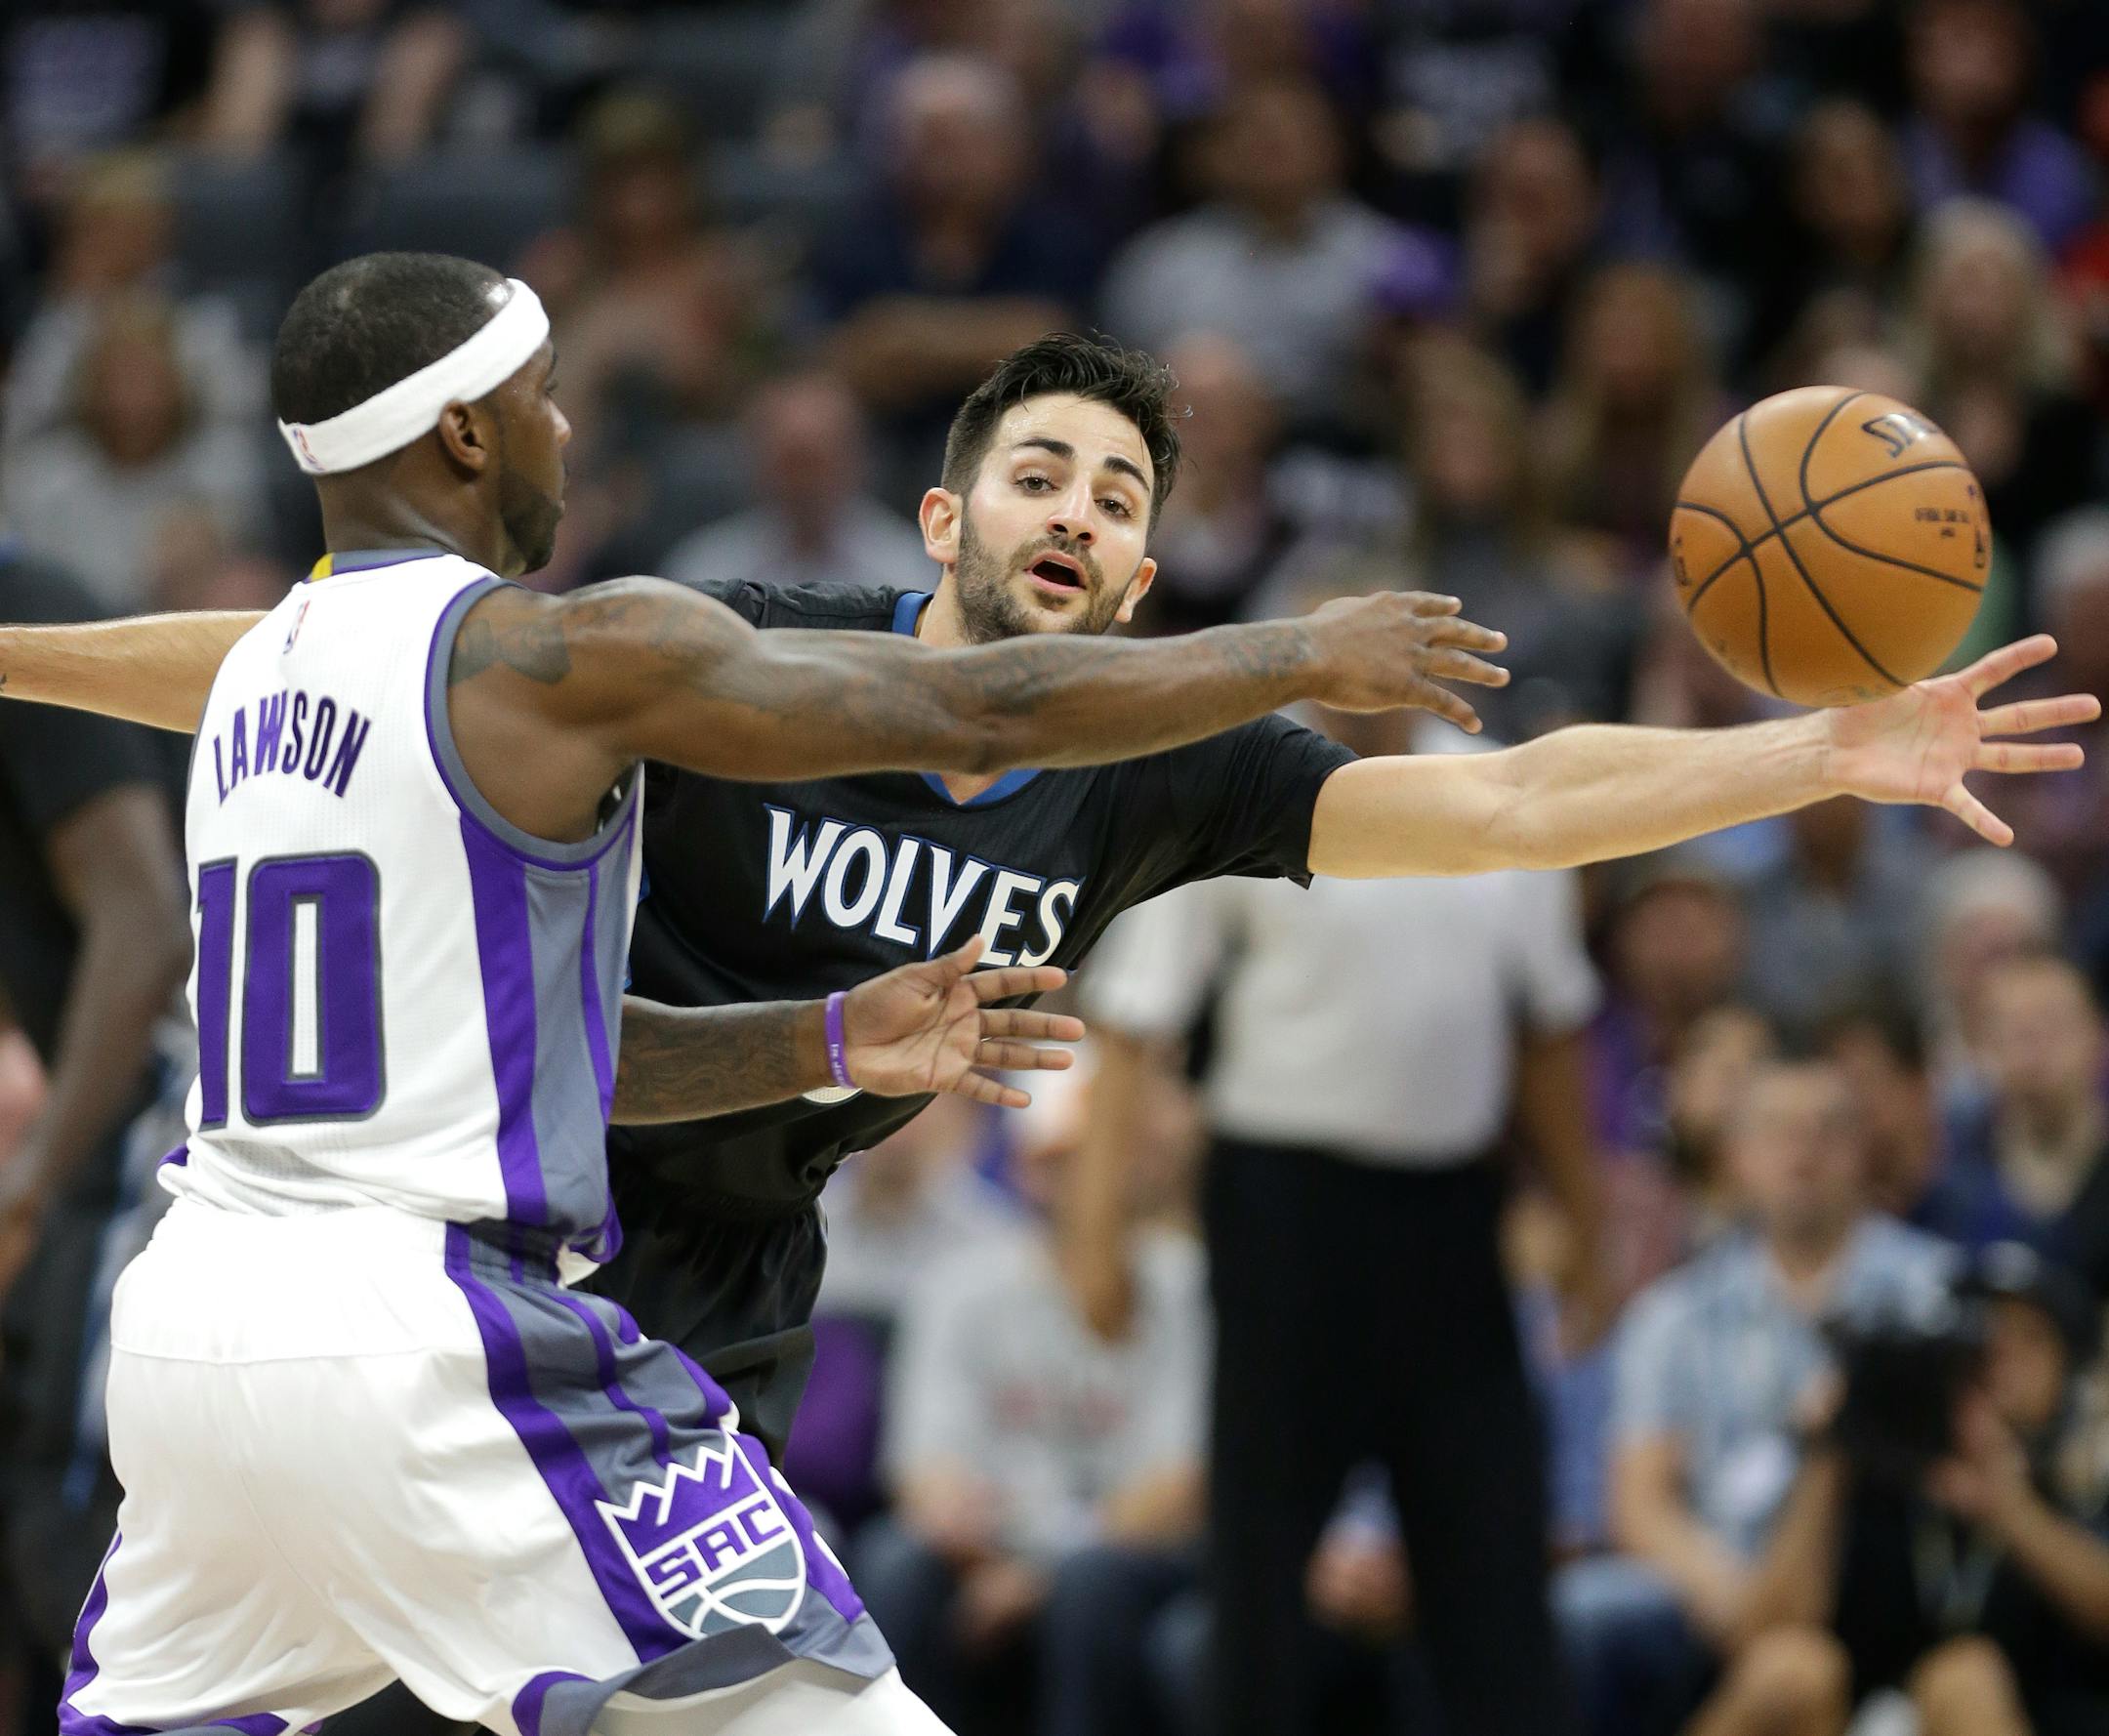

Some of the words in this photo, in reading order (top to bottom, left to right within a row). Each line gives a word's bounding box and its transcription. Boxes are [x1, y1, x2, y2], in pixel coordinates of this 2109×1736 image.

[213, 689, 371, 806] LAWSON
[763, 803, 1086, 969] WOLVES
[196, 849, 387, 1131] 10
[644, 1500, 785, 1599] SAC
